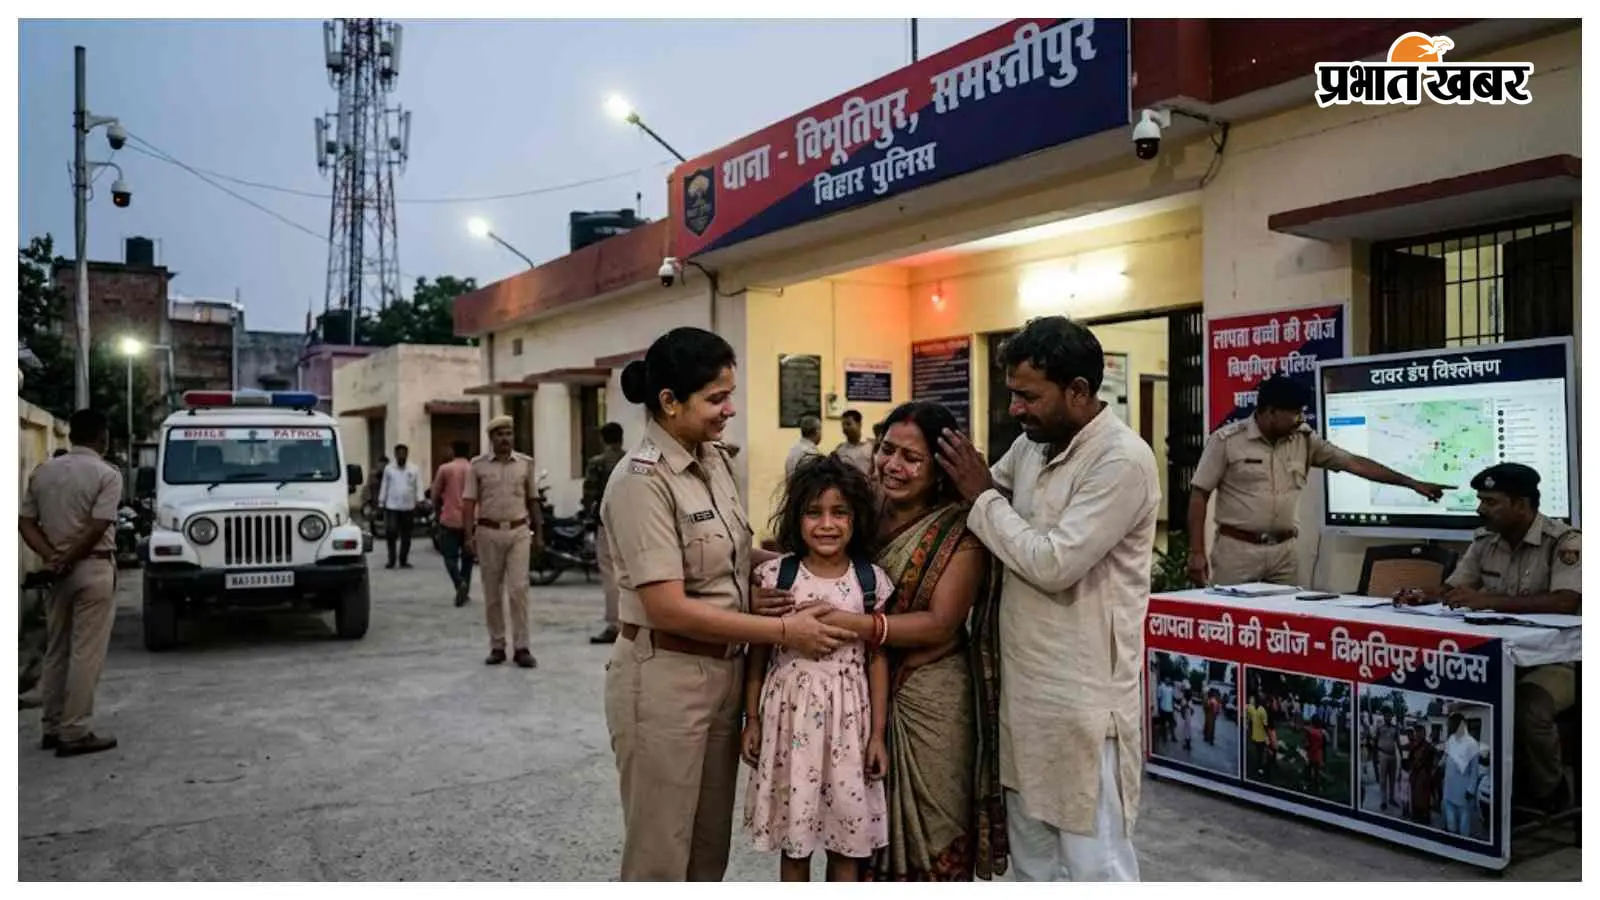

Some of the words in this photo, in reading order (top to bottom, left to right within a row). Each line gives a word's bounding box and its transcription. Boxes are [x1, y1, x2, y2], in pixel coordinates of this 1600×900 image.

[723, 144, 771, 190] थाना
[795, 88, 919, 166] विभूतिपुर,
[930, 18, 1097, 114] समस्तीपुर
[813, 172, 865, 205] बिहार
[870, 142, 937, 195] पुलिस
[1212, 327, 1250, 350] लापता
[1283, 316, 1301, 342] की
[1370, 367, 1404, 384] टावर
[1407, 361, 1429, 382] डंप
[1432, 356, 1501, 380] विश्लेषण
[272, 430, 323, 439] PATROL
[1149, 612, 1194, 640] लापता
[1238, 615, 1262, 650] की
[1266, 621, 1310, 656] खोज
[1331, 625, 1420, 684] विभूतिपुर
[1421, 638, 1490, 689] पुलिस
